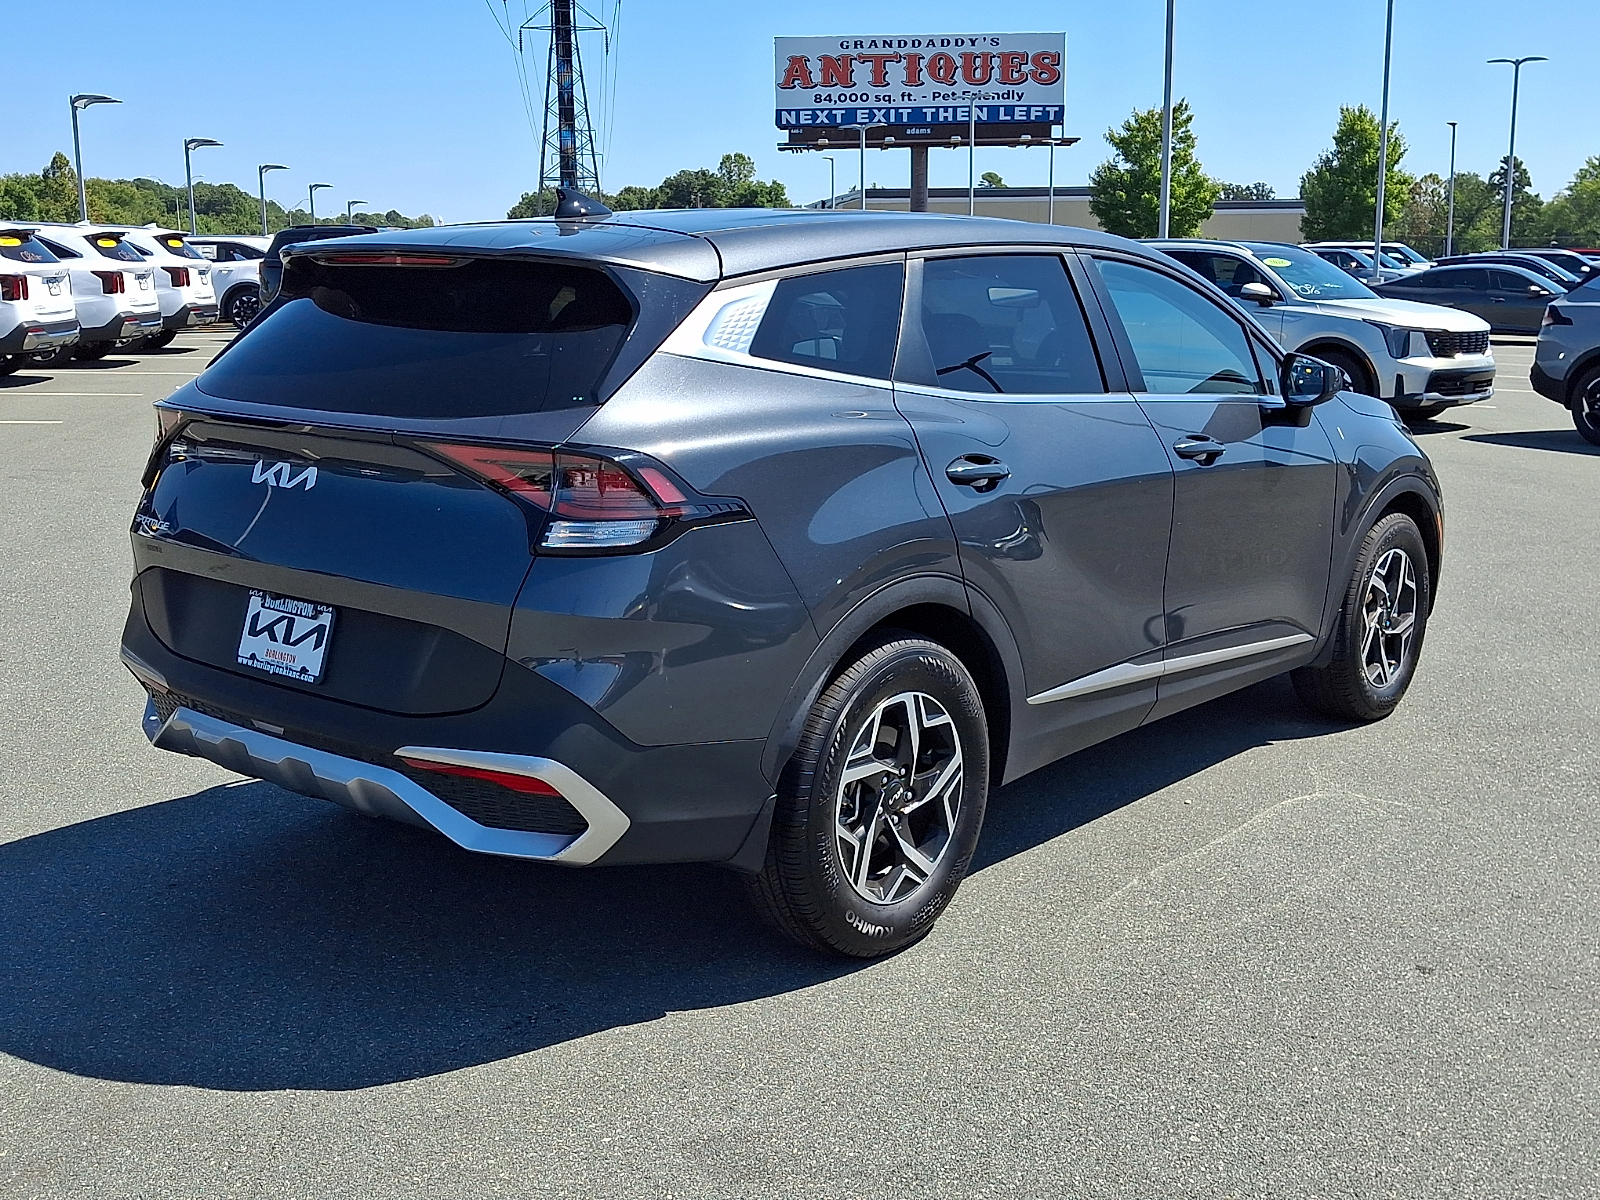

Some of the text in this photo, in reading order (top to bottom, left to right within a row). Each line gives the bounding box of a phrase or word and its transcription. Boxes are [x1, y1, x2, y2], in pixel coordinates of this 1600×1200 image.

[840, 37, 1001, 50] GRANDDADDY'S
[777, 51, 1063, 89] ANTIQUES
[813, 92, 870, 105] 84,000
[874, 94, 897, 104] sq.
[900, 91, 917, 102] ft.
[781, 106, 1060, 125] NEXT EXIT THEN LEFT
[906, 127, 931, 135] adams
[251, 459, 318, 491] KIA
[264, 594, 315, 618] BURLINGTON
[247, 609, 328, 653] KIA
[265, 648, 297, 664] BURLINGTON
[845, 909, 894, 938] KUMHO
